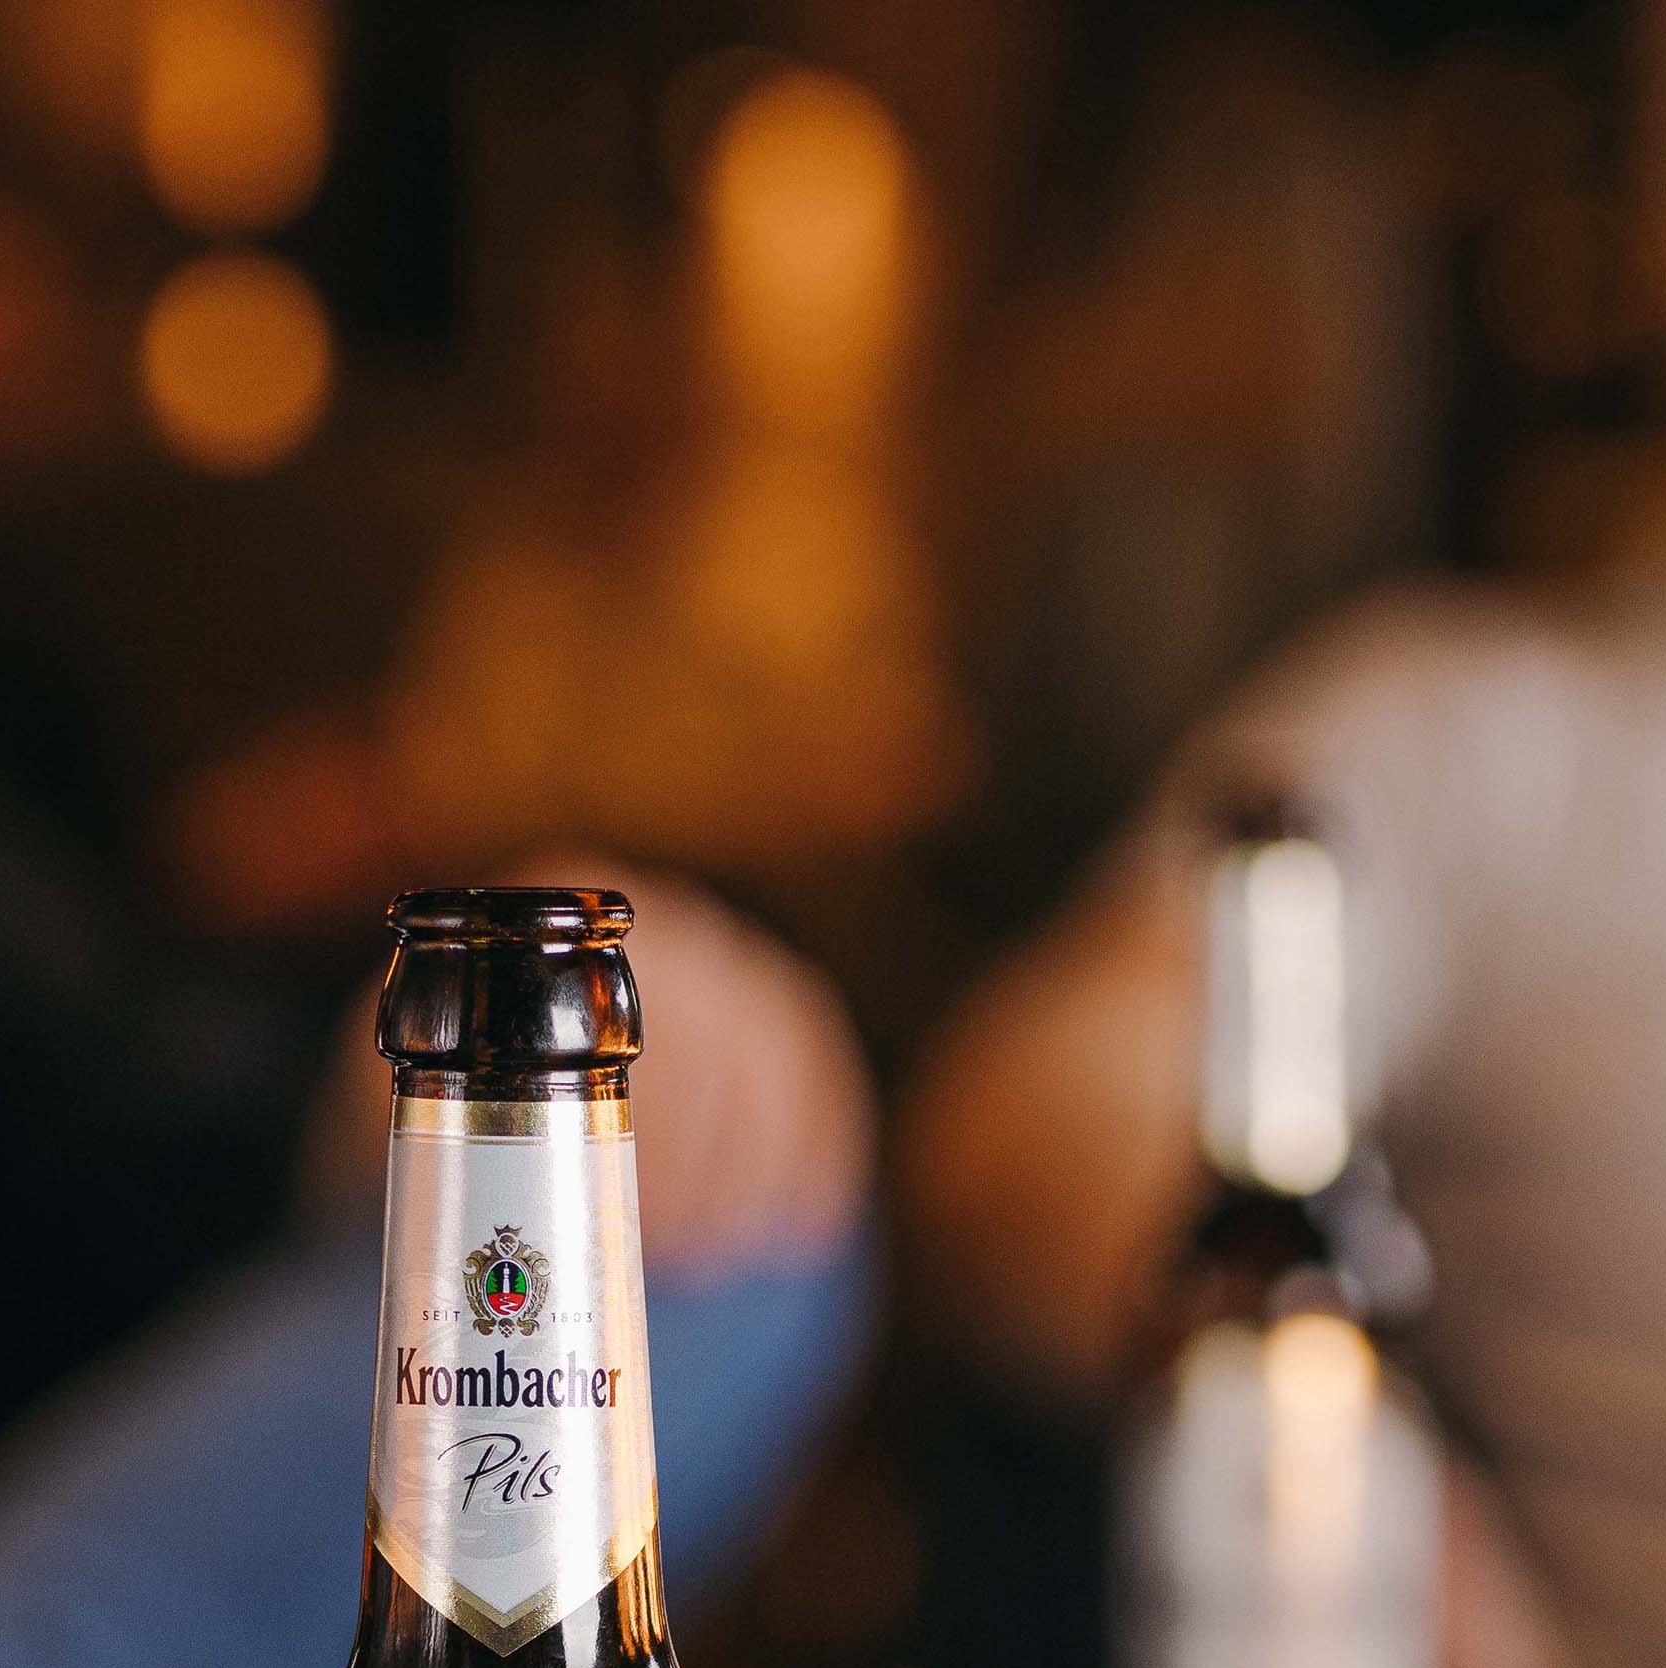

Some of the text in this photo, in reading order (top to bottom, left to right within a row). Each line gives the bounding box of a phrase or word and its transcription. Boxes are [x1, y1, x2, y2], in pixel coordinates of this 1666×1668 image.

[422, 1309, 594, 1323] SEIT 1803
[397, 1348, 621, 1408] Krombacher
[439, 1434, 560, 1513] Pils
